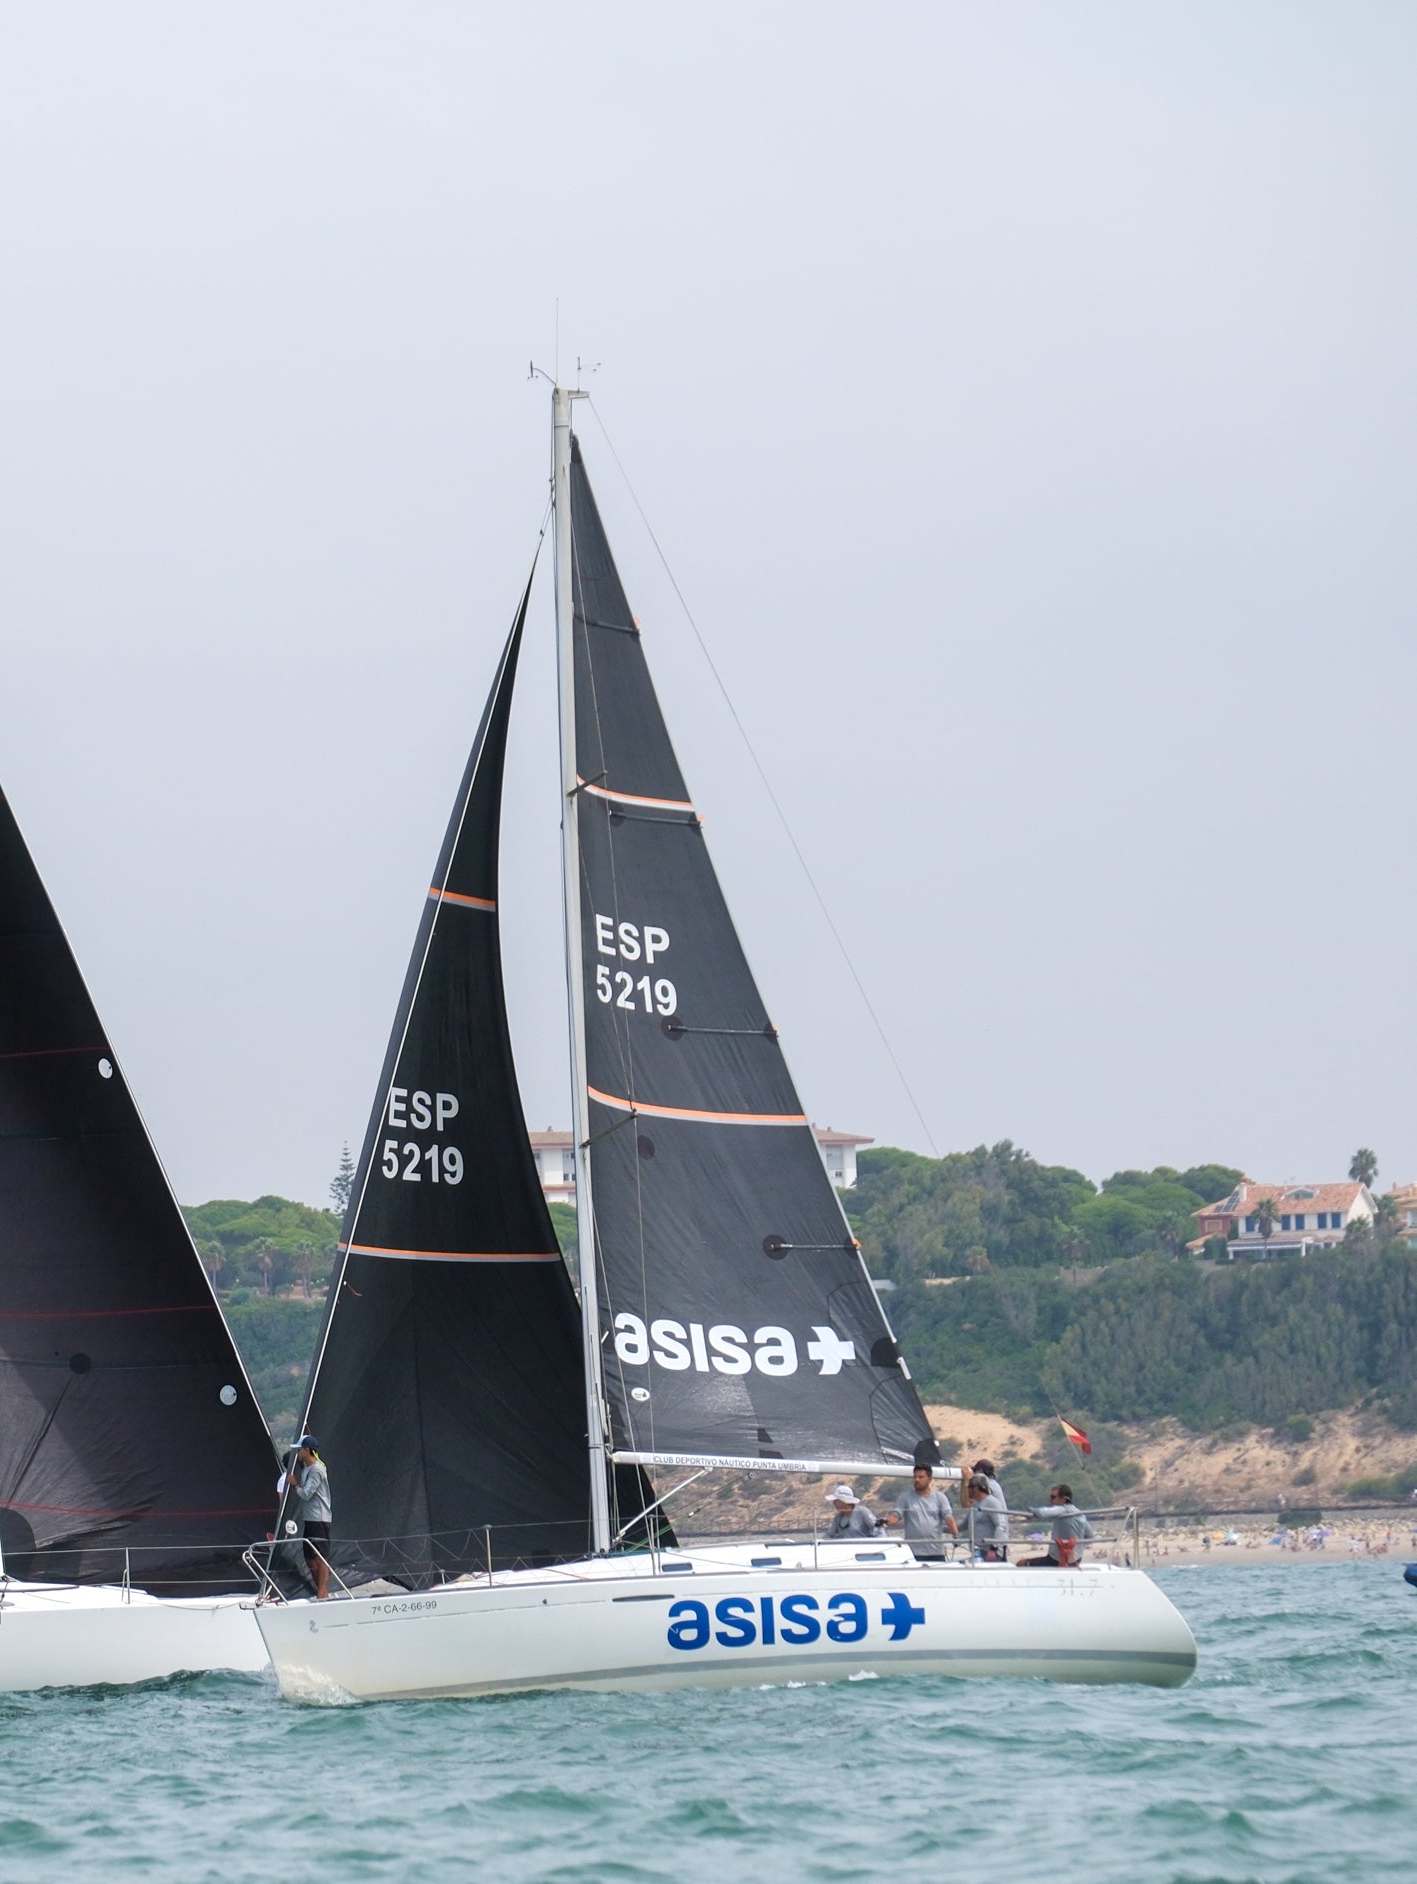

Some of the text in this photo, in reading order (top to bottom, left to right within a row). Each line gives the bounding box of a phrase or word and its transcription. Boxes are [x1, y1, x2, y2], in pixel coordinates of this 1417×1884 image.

[595, 914, 670, 964] ESP
[596, 964, 678, 1016] 5219
[388, 1087, 460, 1132] ESP
[382, 1139, 464, 1185] 5219
[614, 1312, 799, 1377] asisa
[653, 1455, 674, 1464] CLUB
[675, 1456, 718, 1466] DEPORTIVO
[752, 1460, 777, 1469] PUNTA
[383, 1600, 437, 1614] CA-2-66-99
[667, 1593, 868, 1650] asisa
